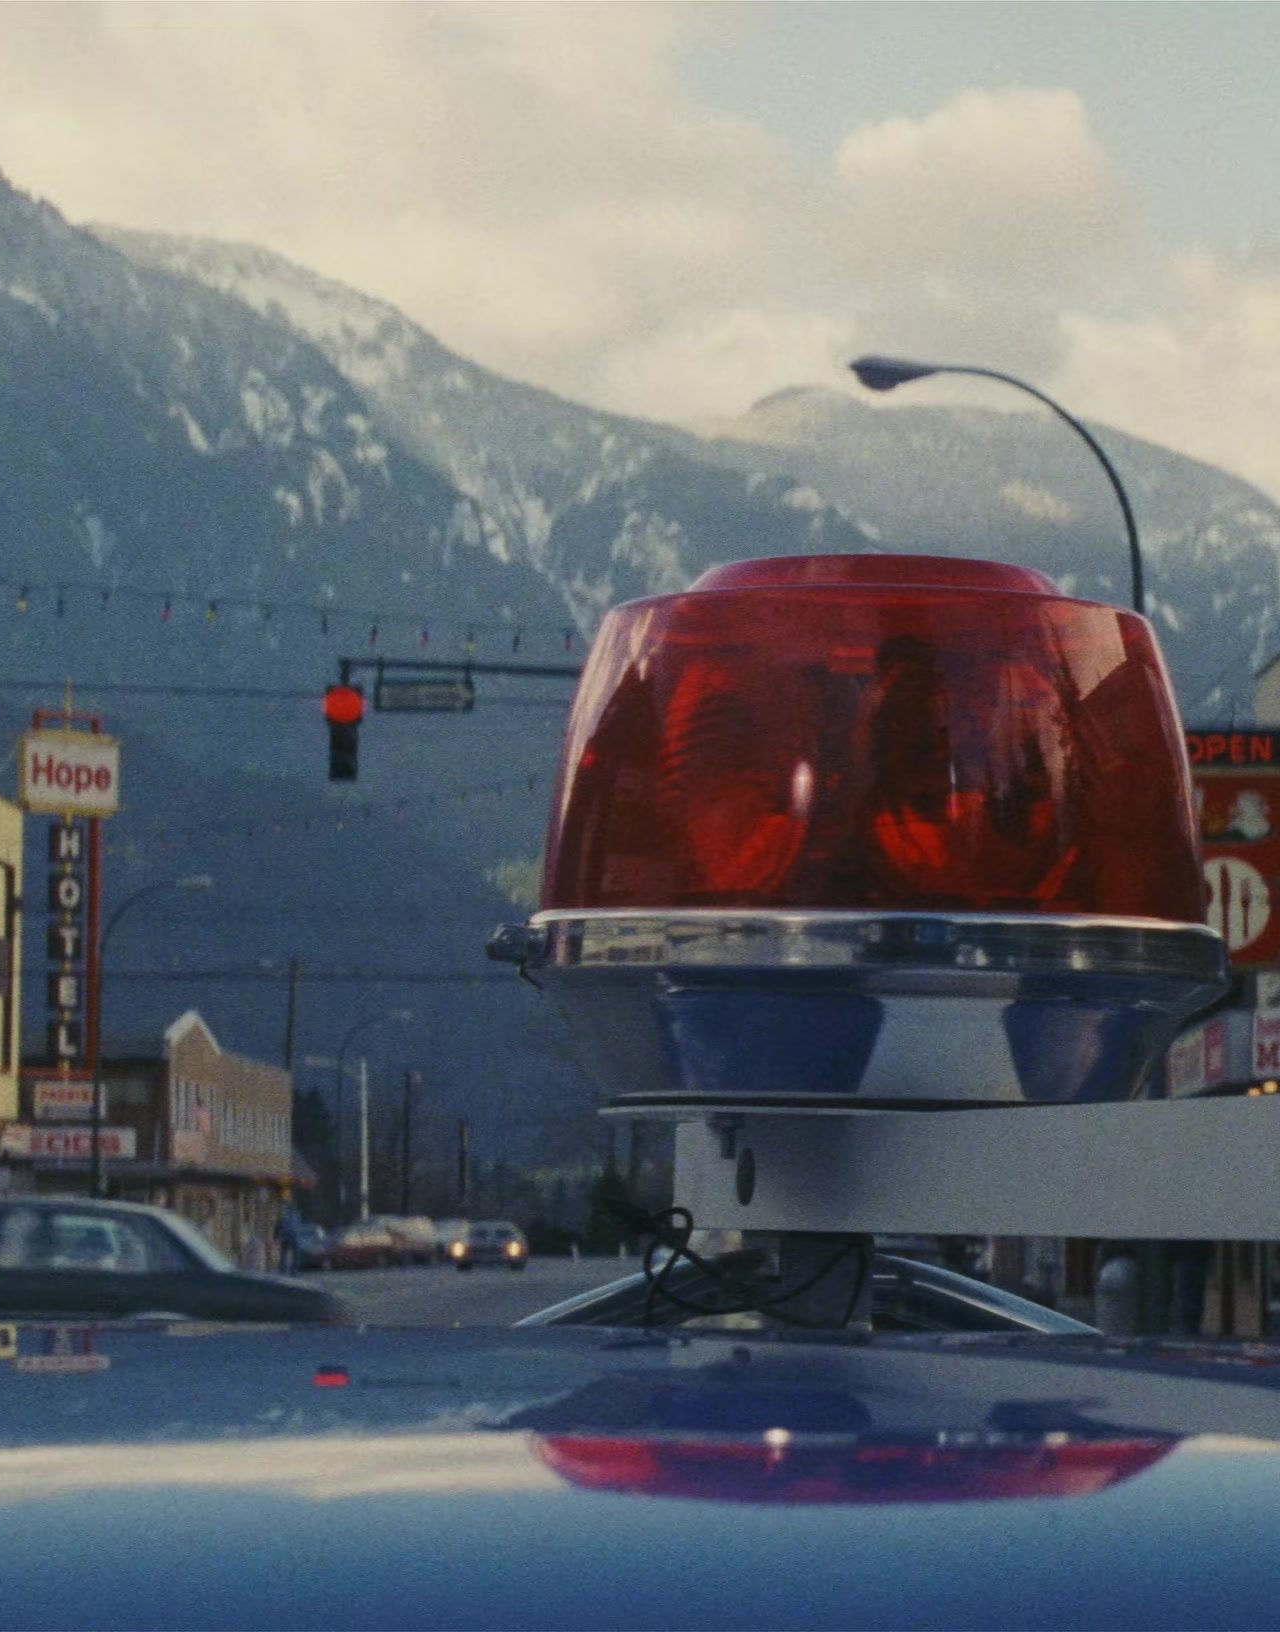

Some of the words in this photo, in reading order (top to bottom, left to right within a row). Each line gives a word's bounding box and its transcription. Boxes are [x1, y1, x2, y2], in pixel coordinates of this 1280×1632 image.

[1186, 734, 1275, 763] OPEN
[30, 754, 112, 795] Hope
[56, 826, 82, 1057] HOTEL
